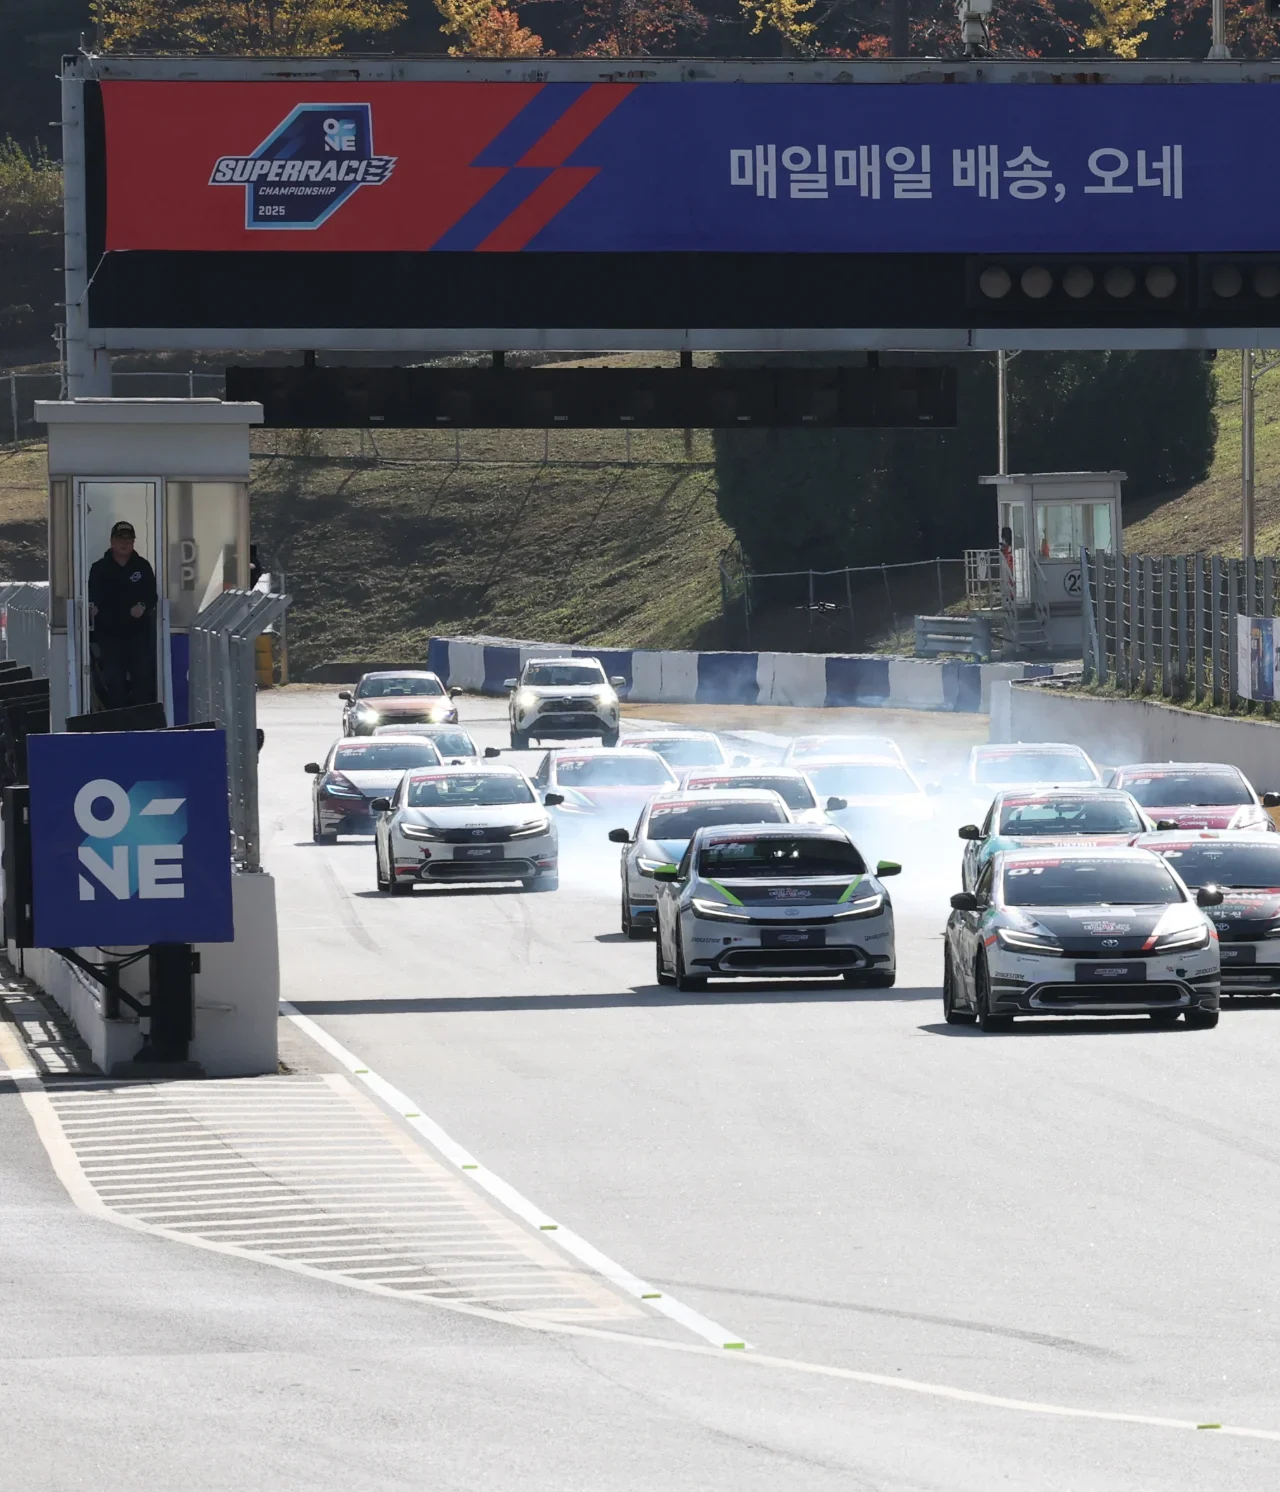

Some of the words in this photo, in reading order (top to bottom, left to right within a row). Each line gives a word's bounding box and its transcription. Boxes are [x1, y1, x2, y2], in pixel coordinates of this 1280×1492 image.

[729, 143, 933, 200] 매일매일
[952, 143, 1067, 204] 배송,
[1084, 143, 1184, 200] 오네
[257, 186, 337, 196] CHAMPIONSHIP
[257, 205, 286, 216] 2025
[1007, 867, 1045, 876] 01
